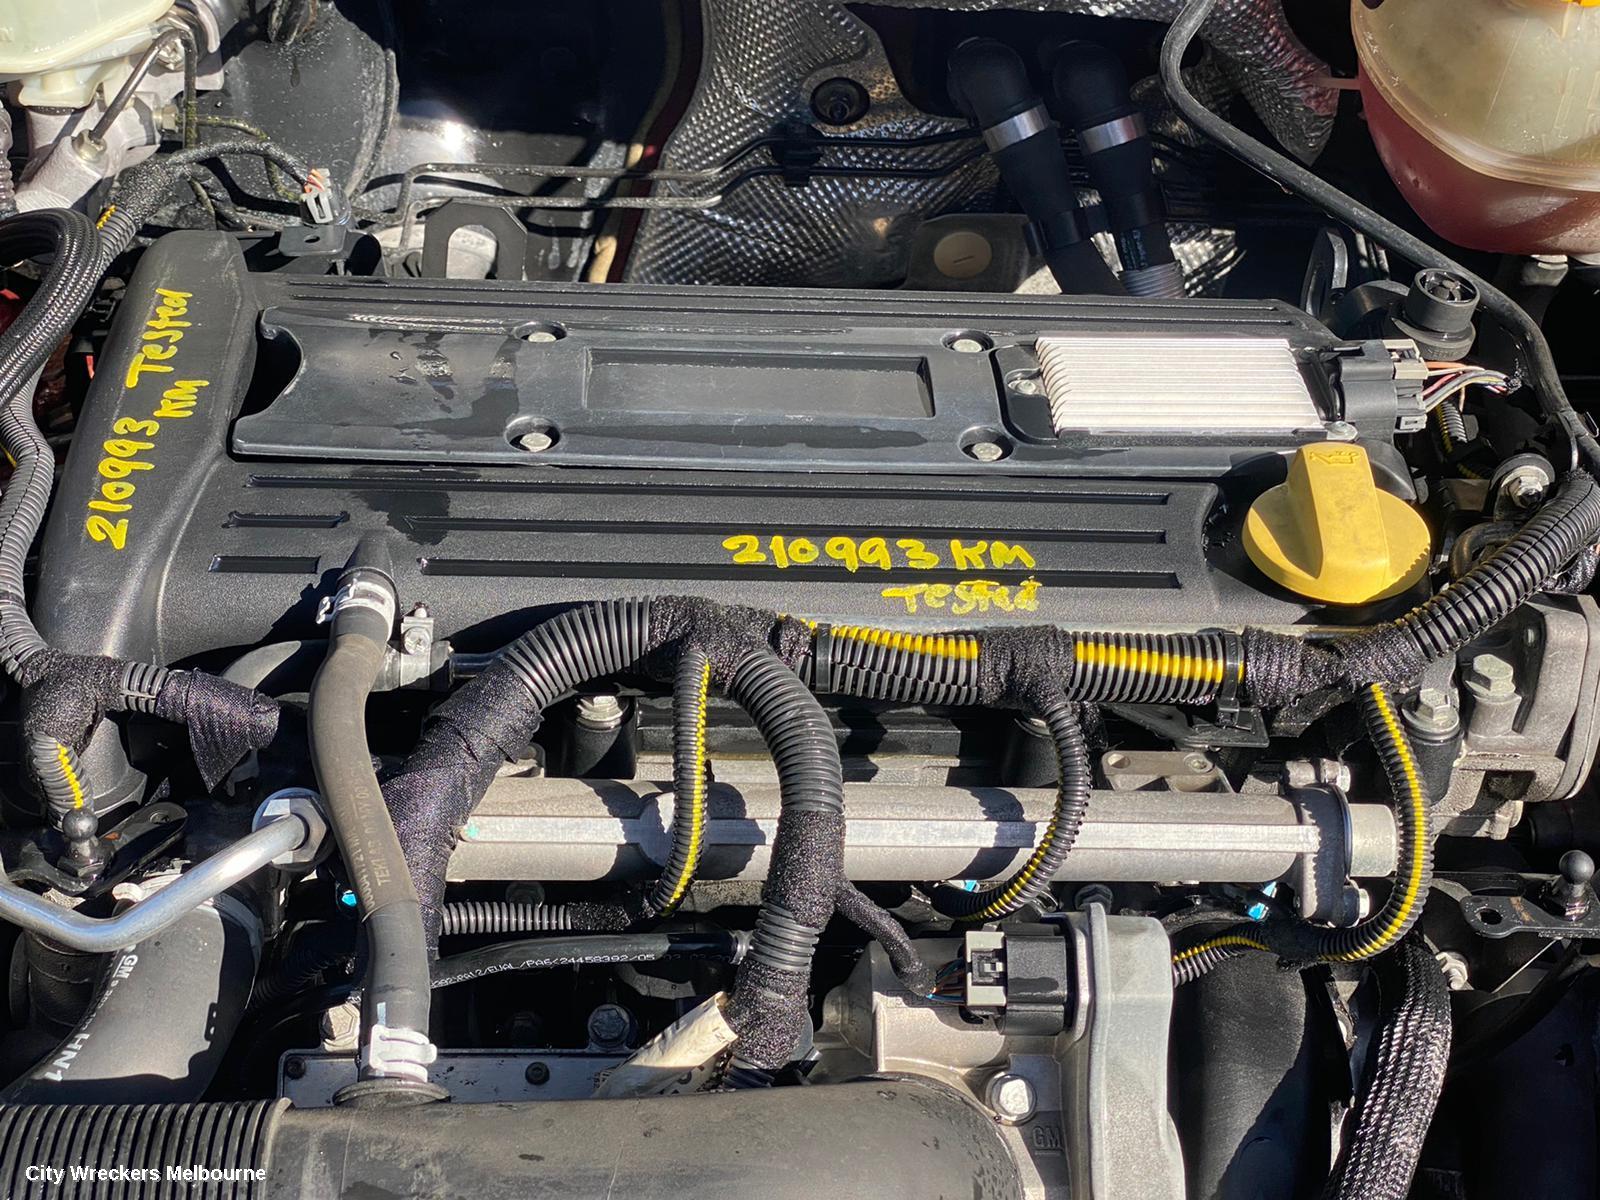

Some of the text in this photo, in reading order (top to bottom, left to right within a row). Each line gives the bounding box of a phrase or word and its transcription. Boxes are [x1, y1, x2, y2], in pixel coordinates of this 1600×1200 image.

[125, 288, 193, 389] Tested
[86, 416, 160, 550] 210993
[722, 535, 940, 573] 210993
[117, 954, 139, 979] GM
[44, 1033, 90, 1082] HN1
[1032, 1125, 1064, 1149] GM
